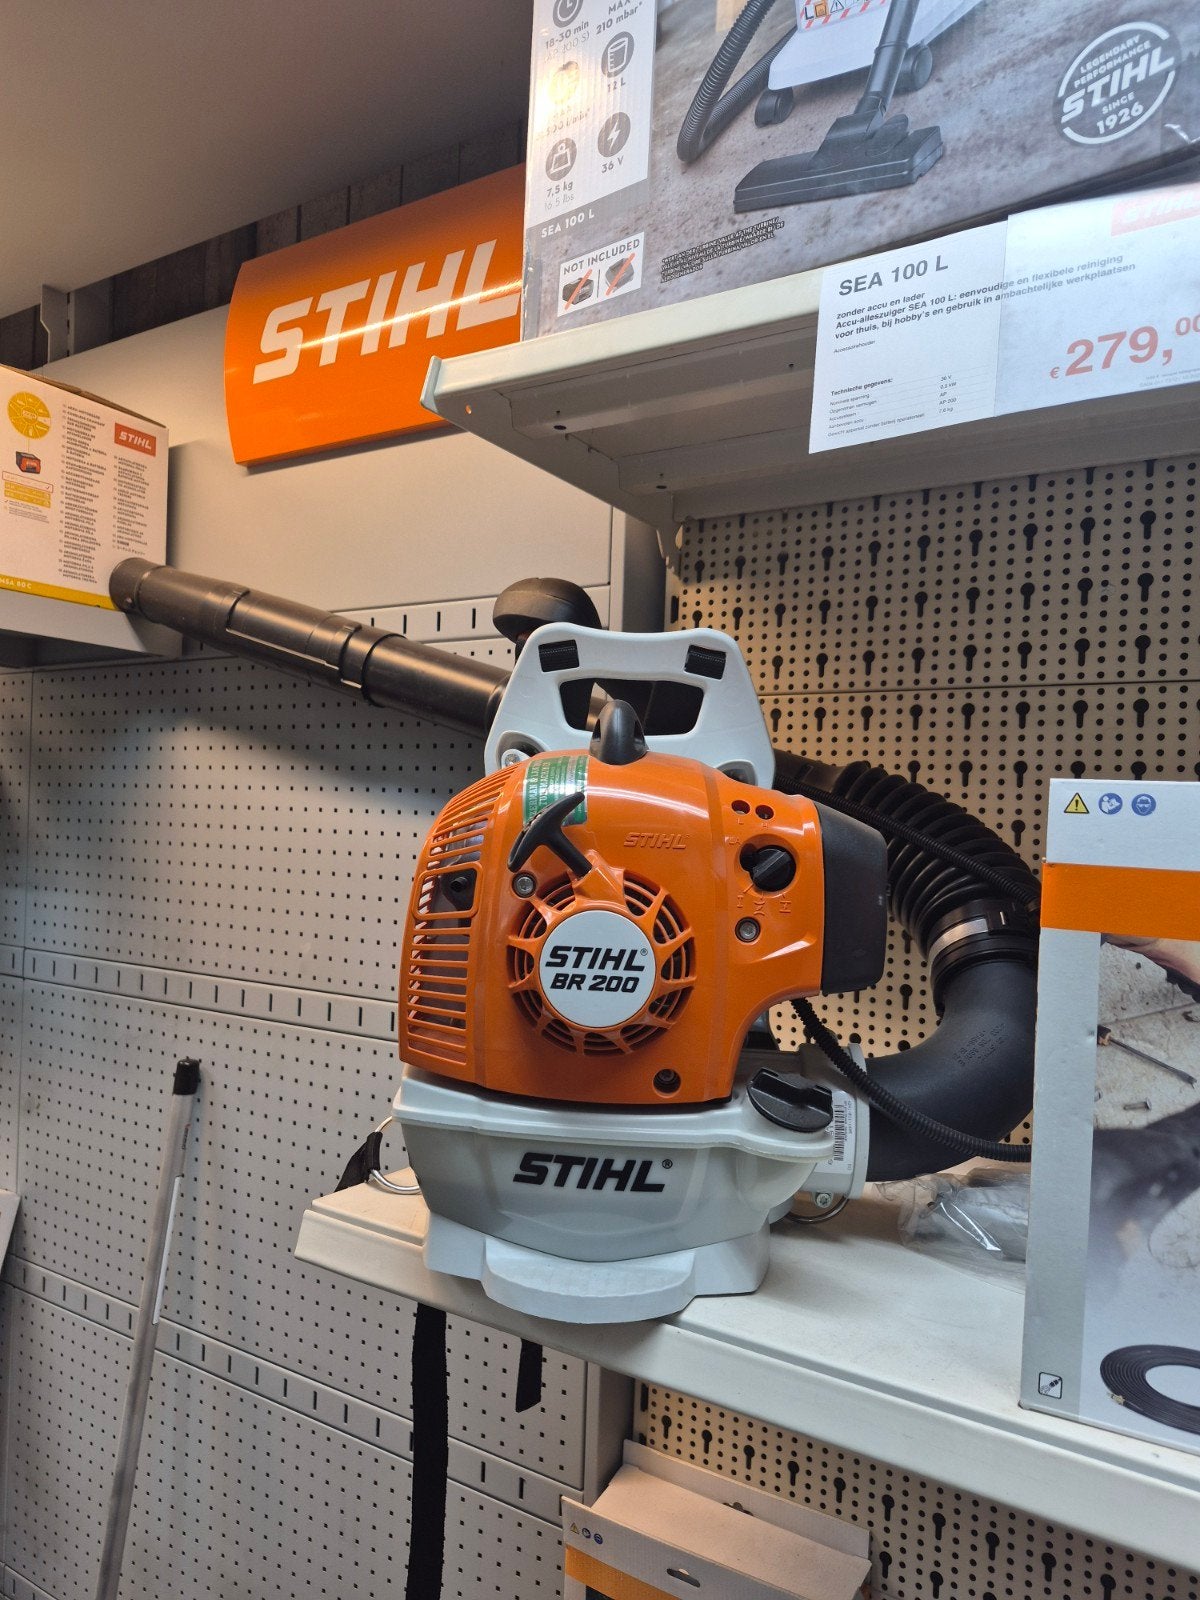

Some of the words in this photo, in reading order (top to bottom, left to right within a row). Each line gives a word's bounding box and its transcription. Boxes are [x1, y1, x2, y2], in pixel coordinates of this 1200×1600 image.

[545, 28, 572, 50] 18-30
[573, 20, 589, 35] min
[596, 18, 613, 35] 210
[1074, 40, 1151, 89] PERFORMANCE
[1080, 34, 1140, 74] LEGENDARY
[607, 80, 618, 93] 12
[620, 77, 626, 87] L
[1061, 46, 1175, 124] STIHL
[1096, 101, 1144, 135] 1926
[1101, 91, 1136, 115] SINCE
[601, 160, 614, 174] 36
[617, 155, 624, 165] V
[546, 184, 560, 198] 7,5
[563, 181, 574, 191] kg
[541, 225, 562, 239] SEA
[565, 212, 585, 229] 100
[588, 208, 595, 219] L
[563, 260, 585, 276] NOT
[587, 238, 640, 267] INCLUDED
[838, 271, 883, 296] SEA
[892, 259, 928, 283] 100
[935, 254, 949, 272] L
[834, 330, 854, 340] voor
[881, 318, 893, 330] bij
[894, 311, 930, 325] hobby's
[932, 306, 944, 317] en
[945, 299, 982, 315] gebruik
[983, 295, 994, 304] in
[994, 279, 1063, 302] ambachtelijke
[1066, 262, 1136, 286] werkplaatsen
[835, 306, 906, 330] Accu-alleszuiger
[908, 301, 927, 312] SEA
[930, 296, 946, 306] 100
[948, 293, 957, 302] L:
[959, 278, 1015, 300] eenvoudige
[1017, 276, 1029, 286] en
[1032, 265, 1074, 283] flexibele
[1076, 255, 1123, 275] reiniging
[836, 306, 865, 320] zonder
[867, 301, 888, 312] accu
[890, 298, 901, 307] en
[903, 291, 926, 304] lader
[253, 239, 521, 385] STIHL
[119, 431, 152, 450] STIHL
[624, 831, 687, 850] STIHL
[550, 972, 587, 991] BR
[588, 974, 640, 994] 200
